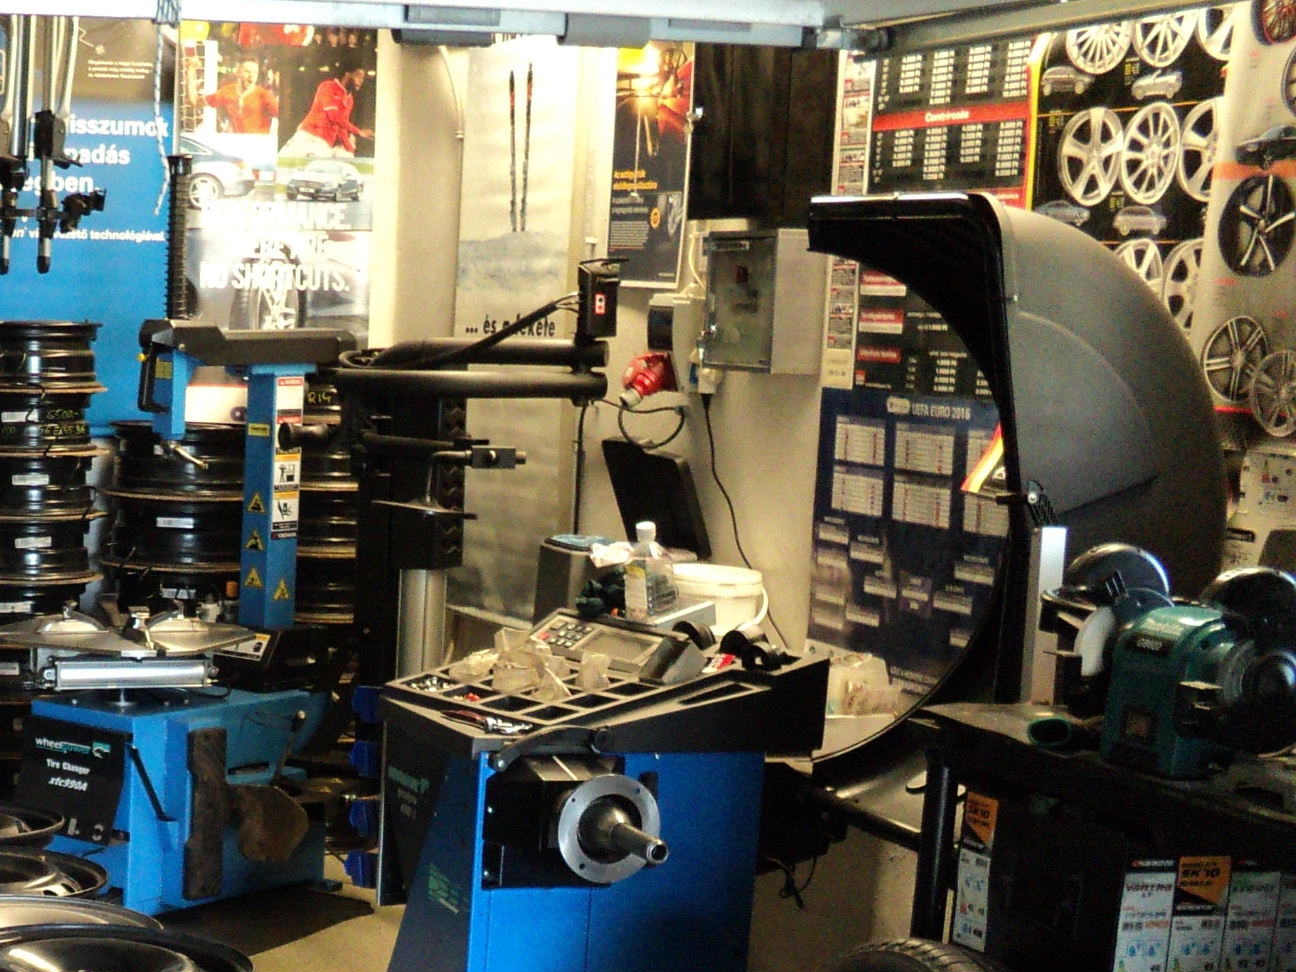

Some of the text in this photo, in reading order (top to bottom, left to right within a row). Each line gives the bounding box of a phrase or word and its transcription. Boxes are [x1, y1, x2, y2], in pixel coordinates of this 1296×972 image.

[912, 403, 971, 420] UEFA EURO 2016
